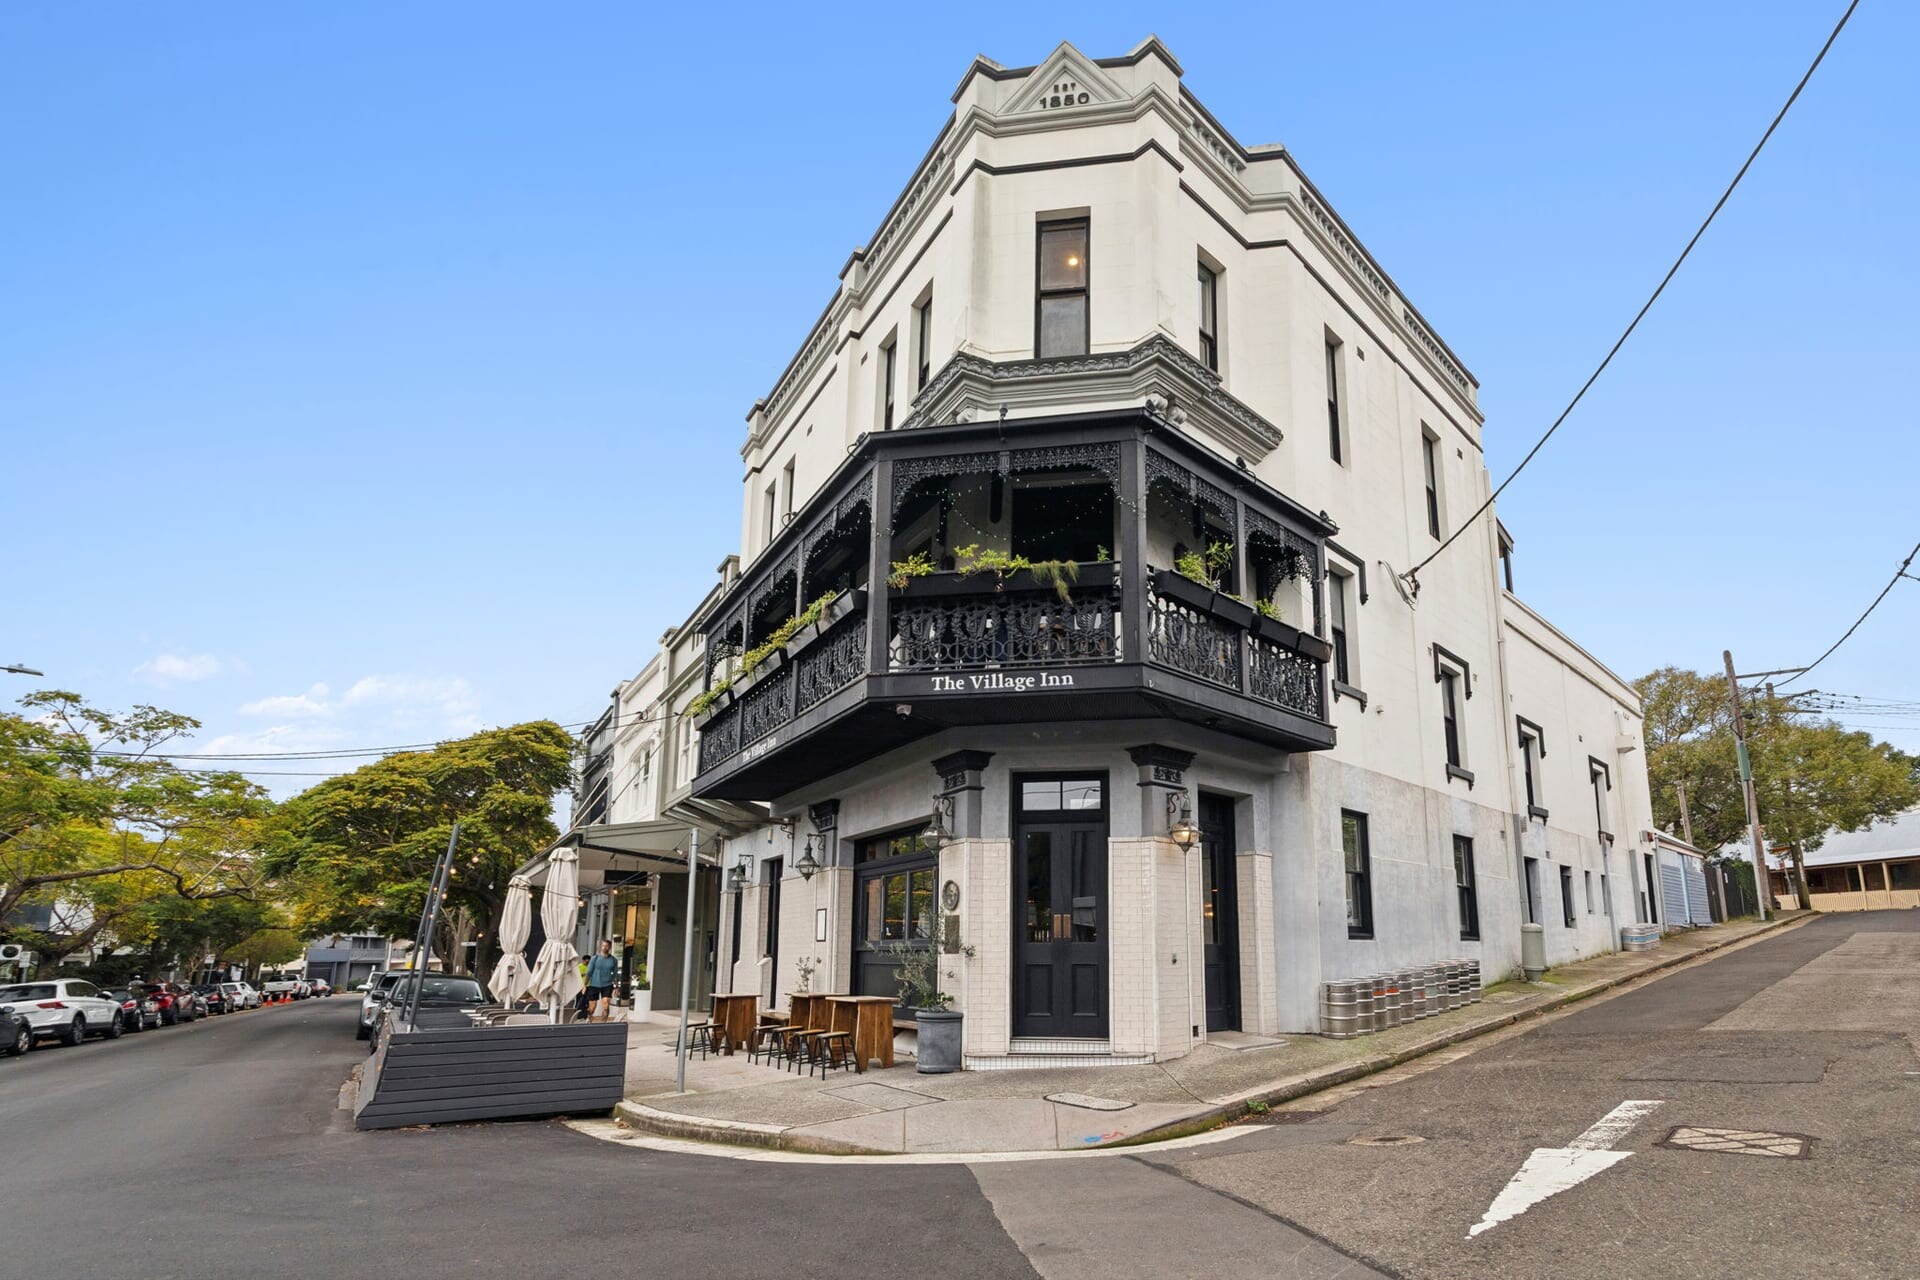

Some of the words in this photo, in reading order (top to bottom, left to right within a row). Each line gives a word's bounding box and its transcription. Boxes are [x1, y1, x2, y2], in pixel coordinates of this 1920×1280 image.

[931, 676, 965, 691] The
[969, 673, 1035, 692] Village
[1040, 672, 1074, 687] Inn
